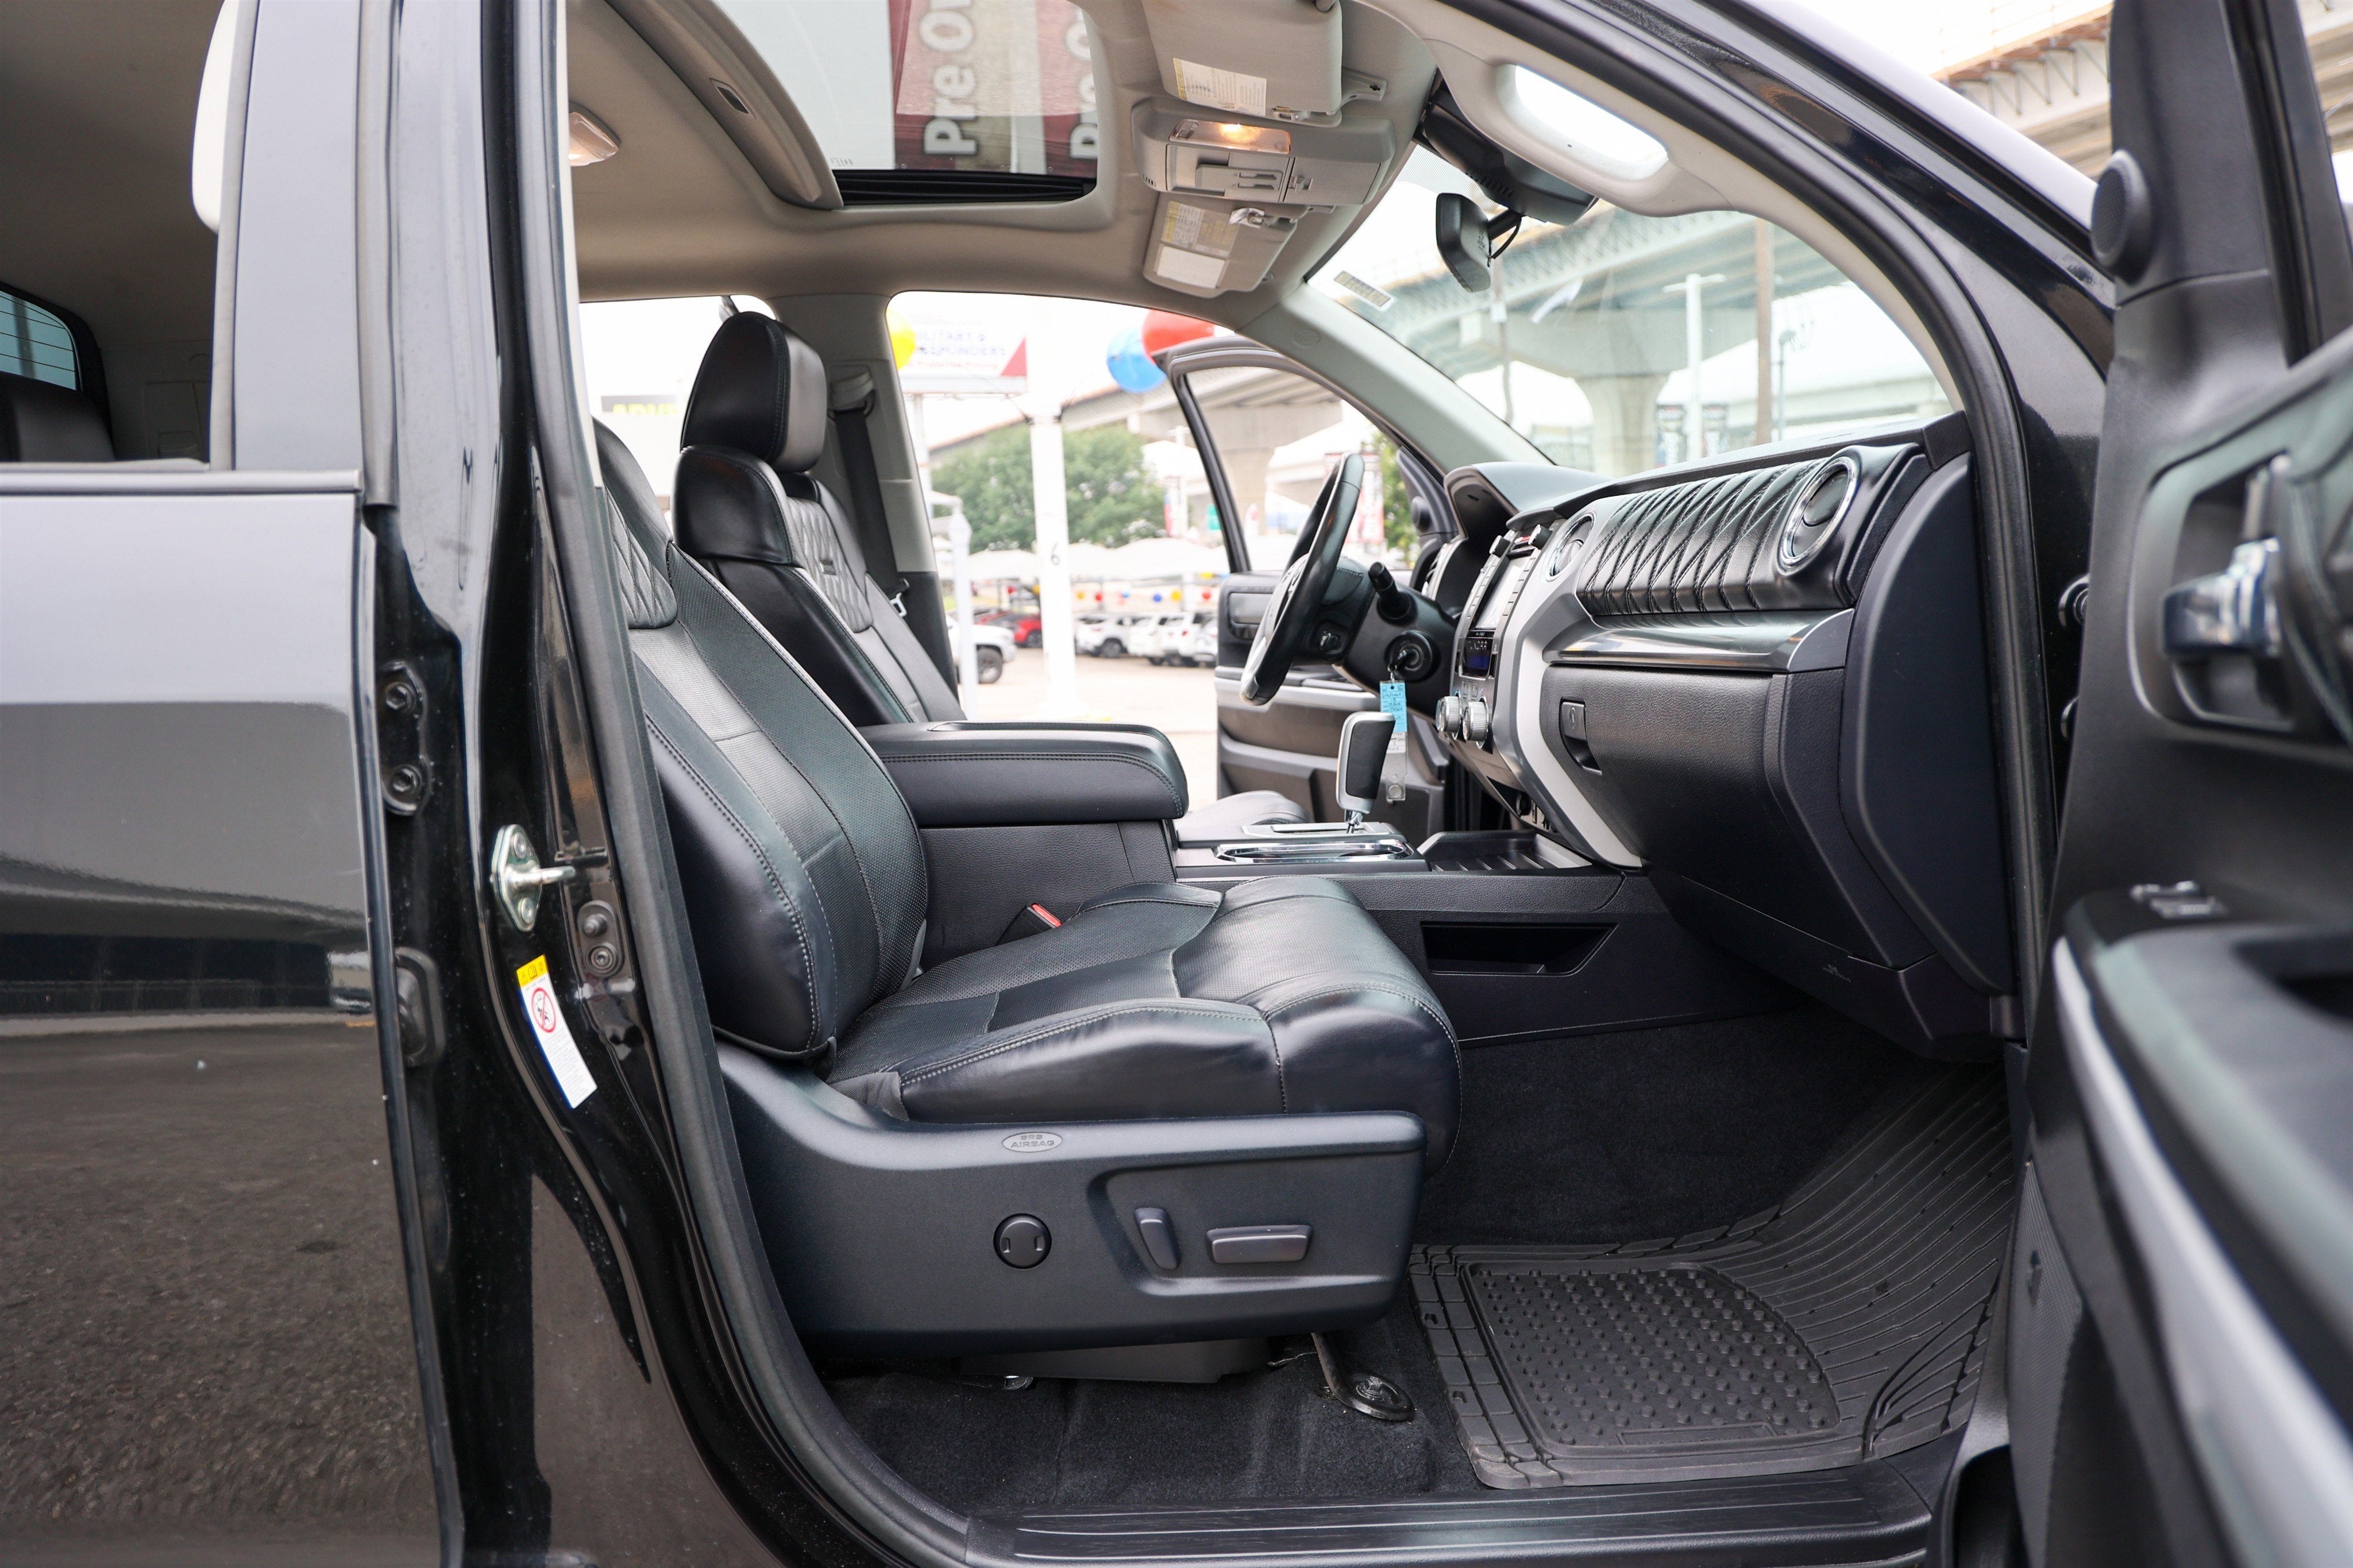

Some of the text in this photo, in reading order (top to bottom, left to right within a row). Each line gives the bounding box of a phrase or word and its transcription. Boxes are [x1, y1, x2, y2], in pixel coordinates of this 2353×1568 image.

[924, 64, 977, 155] Pre
[1050, 541, 1060, 566] 6
[1010, 1140, 1055, 1149] AIRBAG
